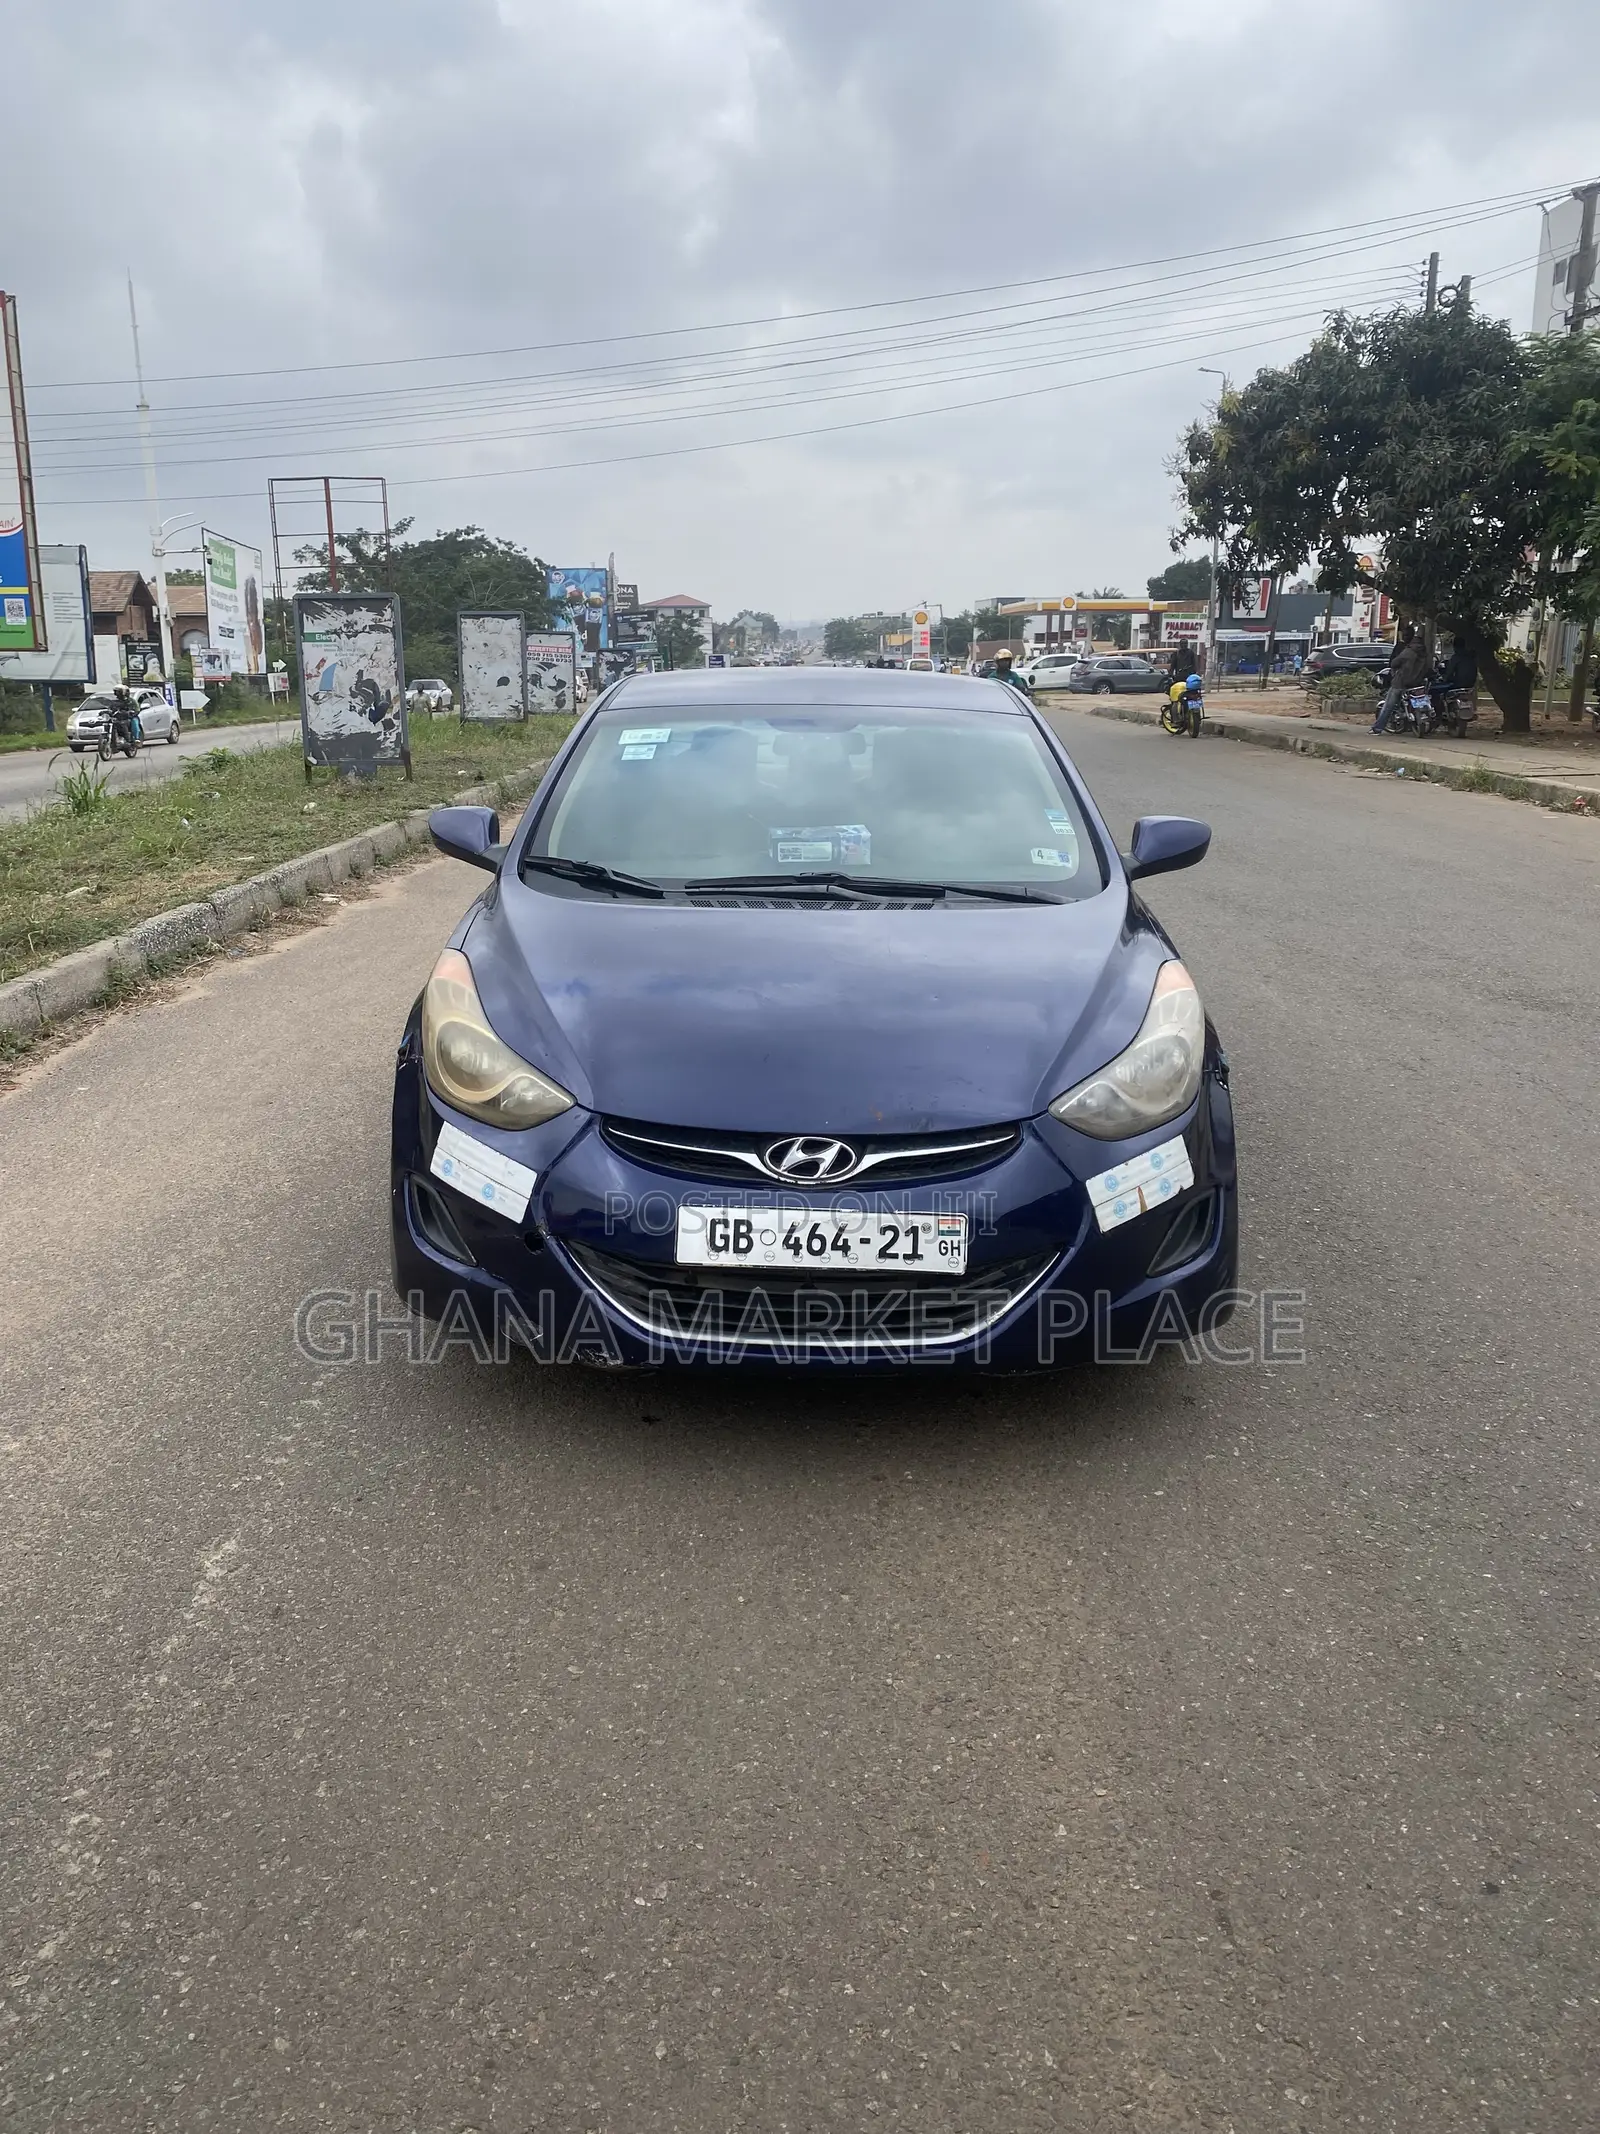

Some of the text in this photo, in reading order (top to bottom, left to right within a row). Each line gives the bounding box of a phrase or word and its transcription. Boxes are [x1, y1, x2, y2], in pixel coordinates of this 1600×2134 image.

[1165, 621, 1204, 631] PHARMACY
[709, 1218, 924, 1261] GB 464-21
[938, 1240, 961, 1256] GH
